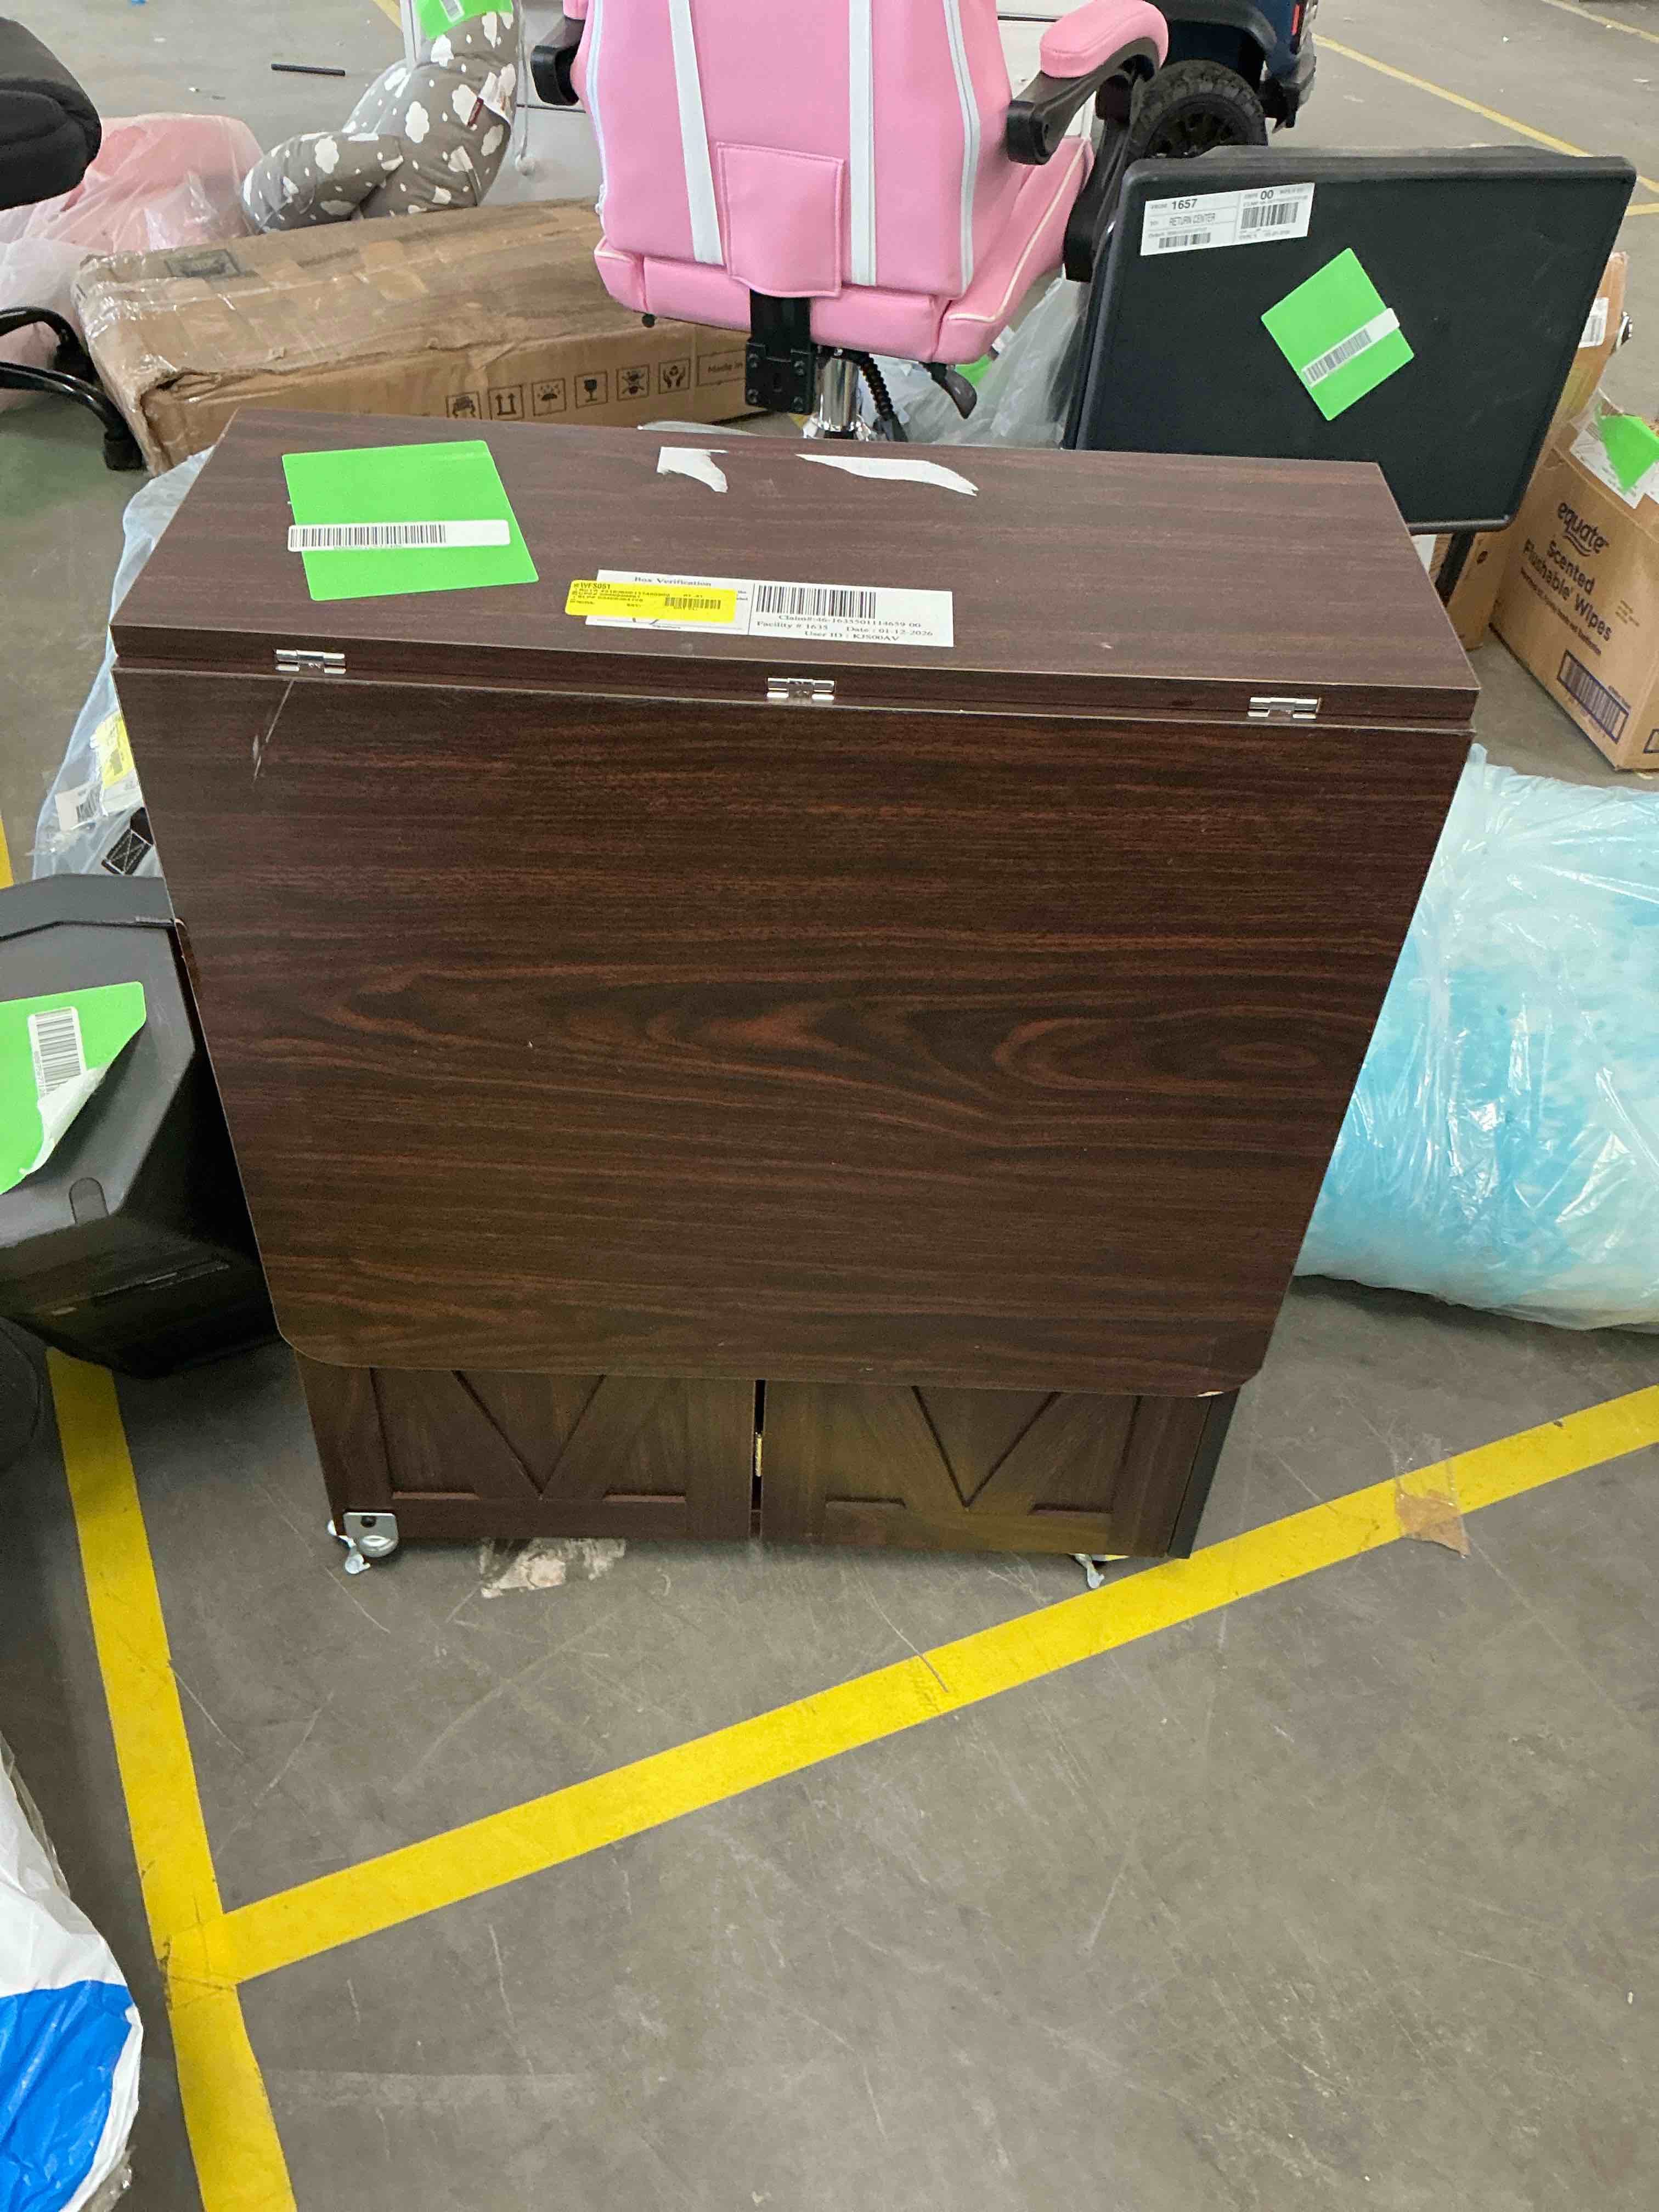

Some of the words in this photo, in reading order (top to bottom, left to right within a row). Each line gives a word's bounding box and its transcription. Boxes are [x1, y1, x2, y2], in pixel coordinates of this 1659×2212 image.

[1260, 190, 1273, 200] 00
[1172, 199, 1198, 210] 1657
[1558, 502, 1605, 554] equate
[1547, 539, 1595, 596] Scented
[657, 578, 712, 586] Verification
[1575, 592, 1612, 641] Wipes
[757, 620, 793, 629] Facility
